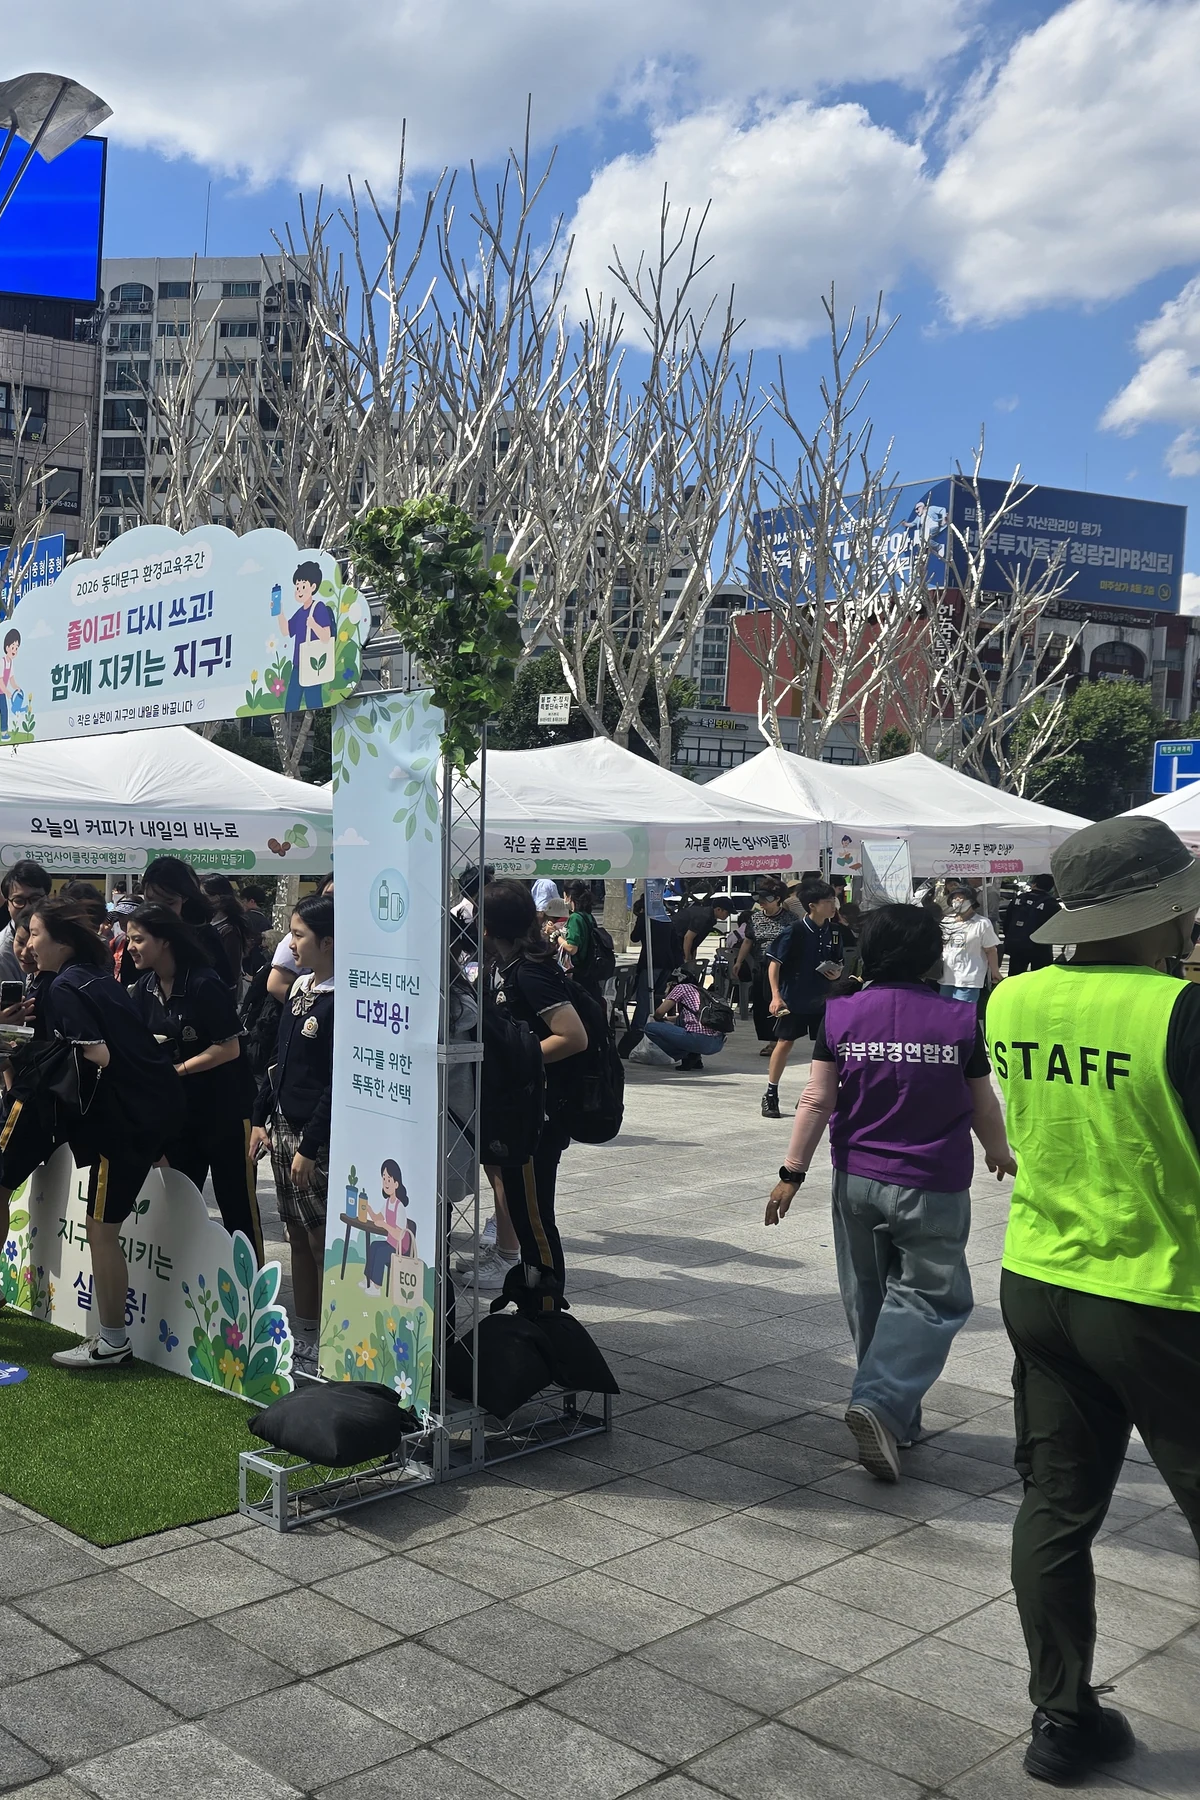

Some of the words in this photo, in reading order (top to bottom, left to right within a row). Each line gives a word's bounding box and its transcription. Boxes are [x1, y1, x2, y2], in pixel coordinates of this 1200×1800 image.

[1002, 512, 1024, 528] 있는
[1026, 515, 1079, 535] 자산관리의
[1080, 522, 1103, 537] 명가
[963, 529, 1069, 565] 한국투자증권
[1070, 541, 1174, 575] 청량리PB센터
[76, 579, 99, 597] 2026
[101, 569, 140, 594] 동대문구
[142, 551, 206, 583] 환경교육주간
[67, 611, 121, 651] 줄이고!
[127, 601, 163, 635] 다시
[168, 590, 214, 628] 쓰고!
[51, 659, 92, 701] 함께
[98, 648, 166, 689] 지키는
[173, 634, 233, 679] 지구!
[76, 713, 91, 727] 작은
[92, 710, 113, 724] 실천이
[114, 707, 136, 722] 지구의
[137, 703, 160, 719] 내일을
[161, 699, 193, 717] 바꿉니다
[30, 816, 78, 839] 오늘의
[85, 819, 135, 838] 커피가
[140, 820, 189, 842] 내일의
[193, 821, 240, 839] 비누로
[685, 836, 711, 852] 지구를
[712, 836, 742, 851] 아끼는
[742, 834, 791, 851] 업사이클링!
[24, 850, 127, 864] 한국업사이클링공예협회
[503, 835, 526, 853] 작은
[530, 836, 542, 853] 숲
[544, 837, 589, 853] 프로젝트
[972, 843, 981, 856] 두
[221, 853, 246, 866] 만들기
[551, 863, 576, 873] 테라리움
[577, 863, 596, 873] 만들기
[348, 968, 393, 993] 플라스틱
[394, 973, 421, 997] 대신
[356, 998, 410, 1035] 다회용!
[352, 1044, 386, 1071] 지구를
[387, 1051, 413, 1076] 위한
[836, 1041, 960, 1065] 주부환경연합회
[993, 1040, 1132, 1091] STAFF
[351, 1071, 386, 1096] 똑똑한
[387, 1079, 412, 1105] 선택
[57, 1217, 91, 1251] 지구
[399, 1270, 417, 1288] ECO
